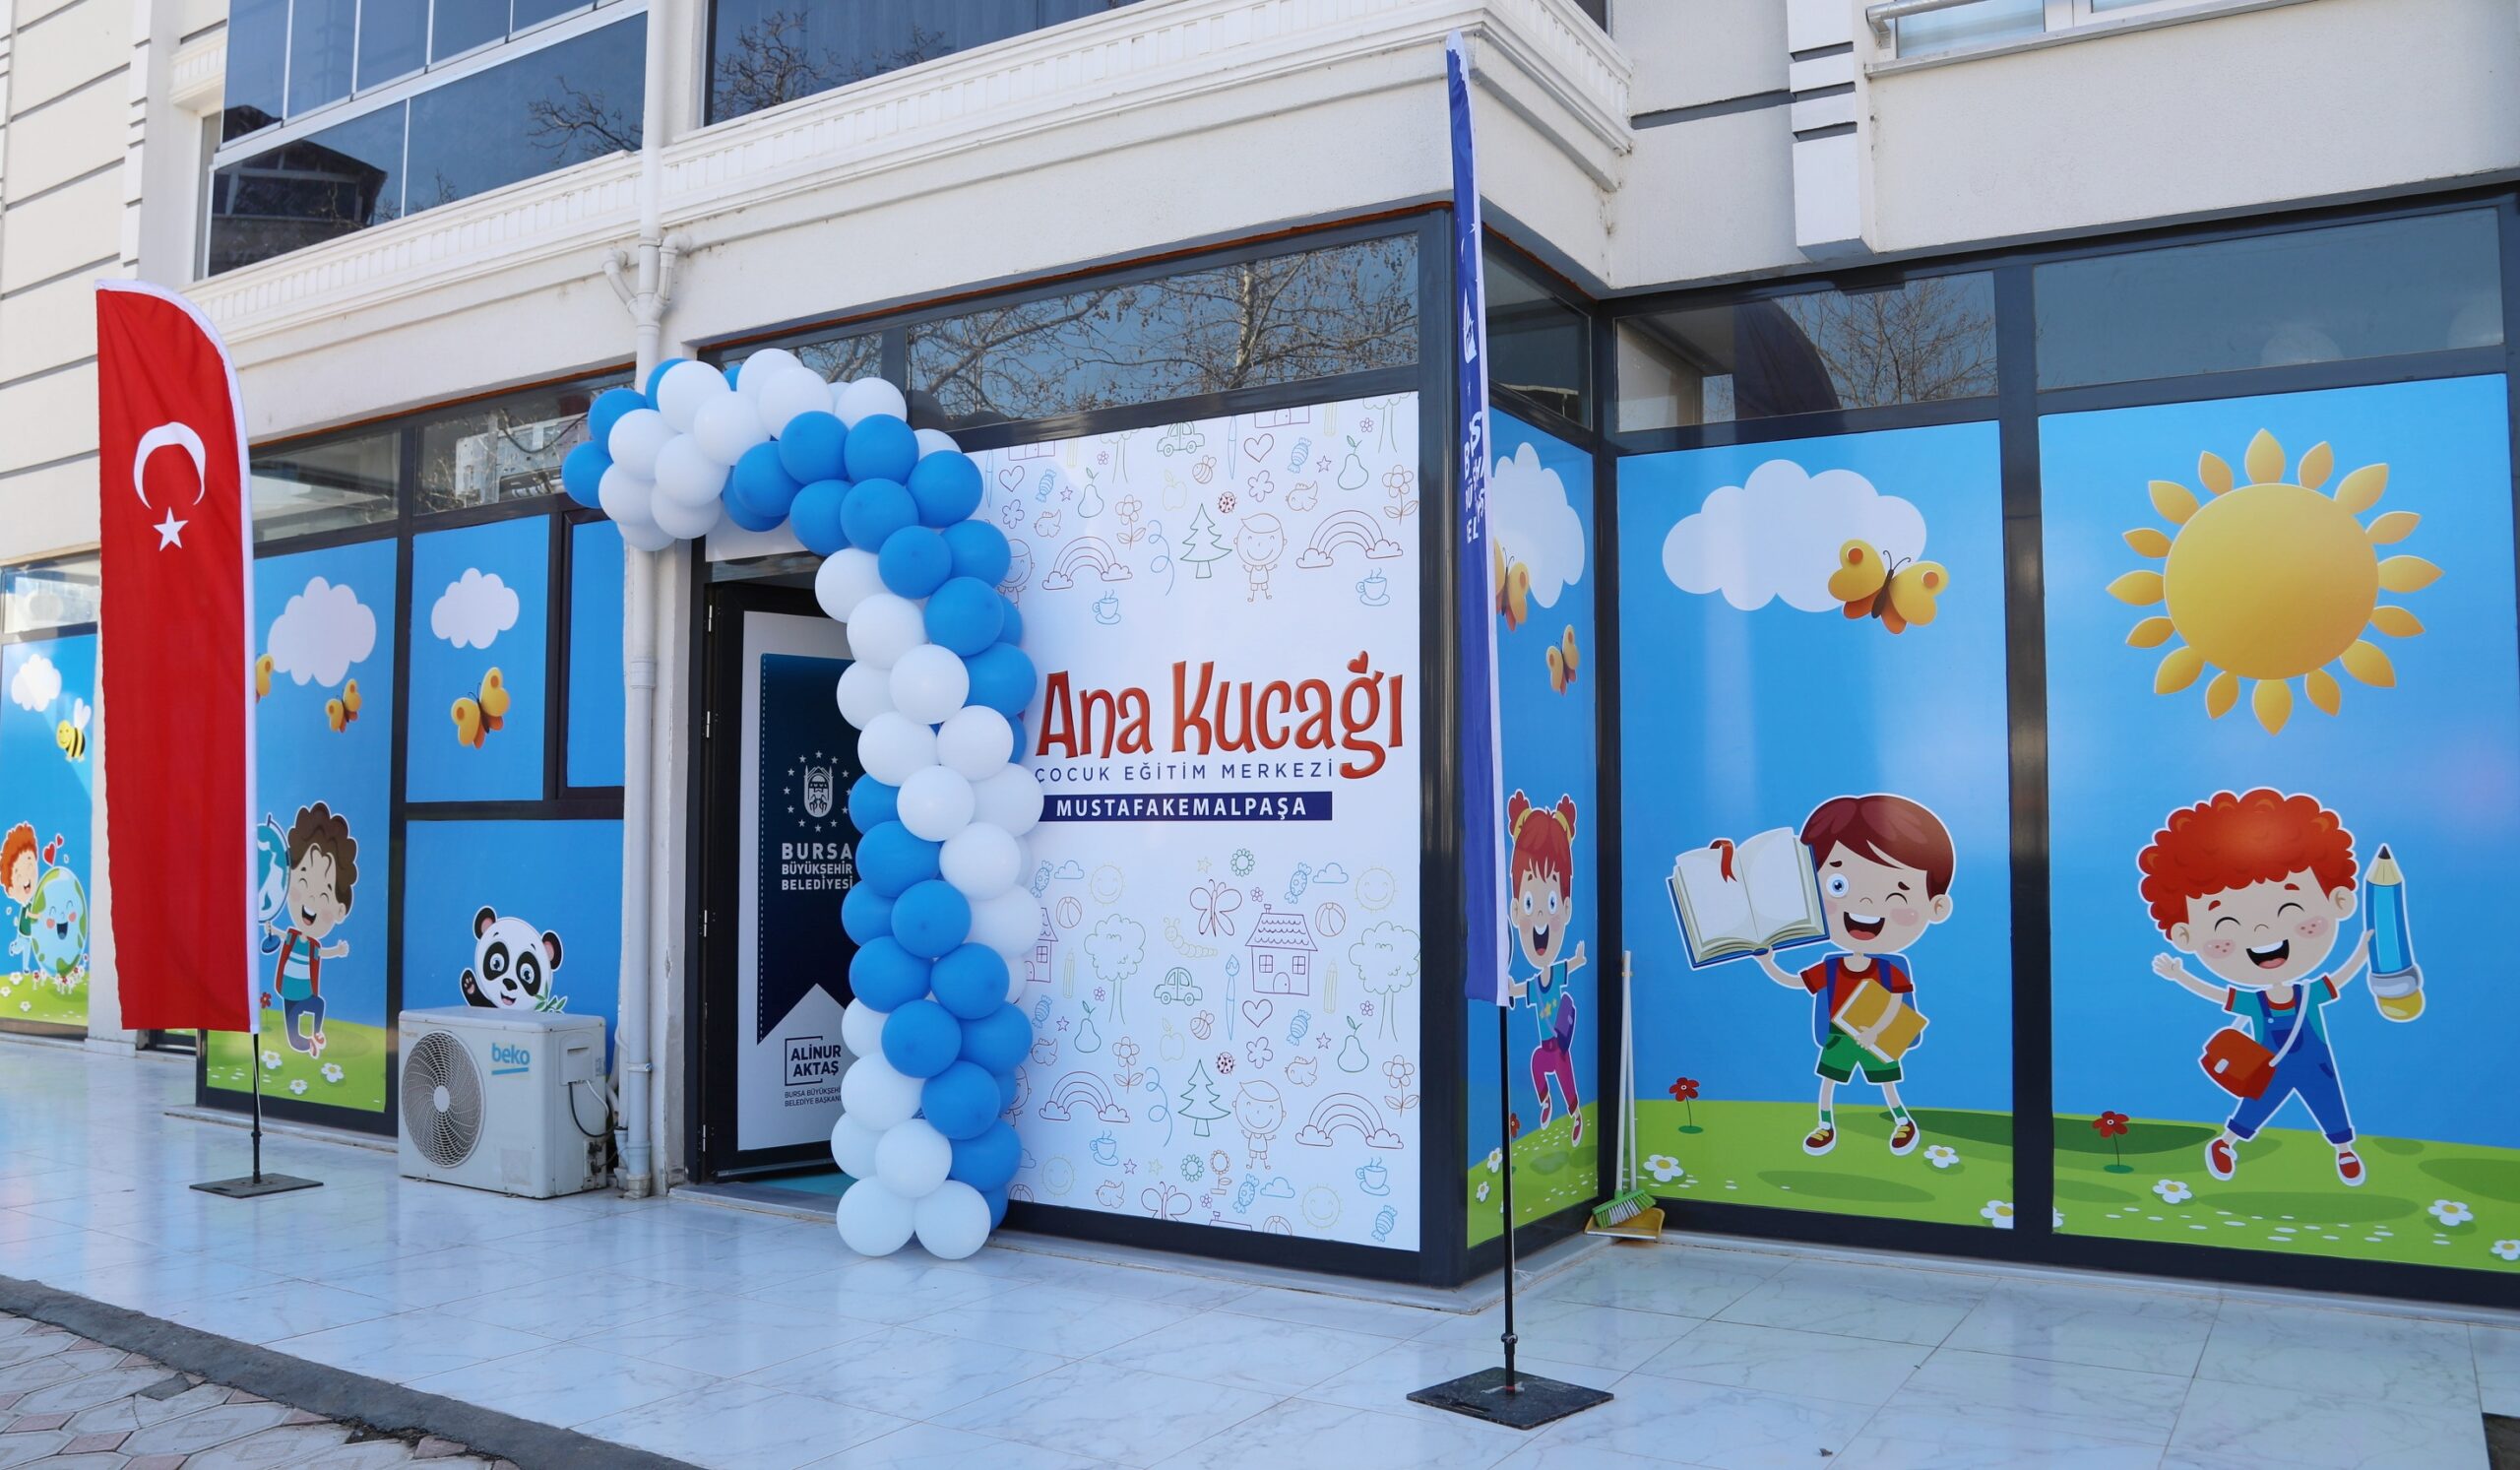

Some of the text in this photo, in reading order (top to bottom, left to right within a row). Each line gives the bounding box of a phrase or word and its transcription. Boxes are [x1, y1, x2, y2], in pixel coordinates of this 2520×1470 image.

[1036, 650, 1404, 780] Ana Kucağı
[1035, 757, 1334, 784] ÇOCUK EĞİTİM MERKEZİ
[1055, 796, 1307, 820] MUSTAFAKEMALPAŞA
[782, 843, 852, 860] BURSA
[782, 861, 852, 877] BÜYÜKŞEHİR
[782, 876, 853, 890] BELEDİYESİ
[492, 1043, 530, 1065] beko
[790, 1044, 842, 1061] ALİNUR
[792, 1060, 840, 1077] AKTAŞ
[785, 1086, 841, 1099] BURSA BÜYÜKŞEHİ
[785, 1098, 814, 1107] BELEDİYE
